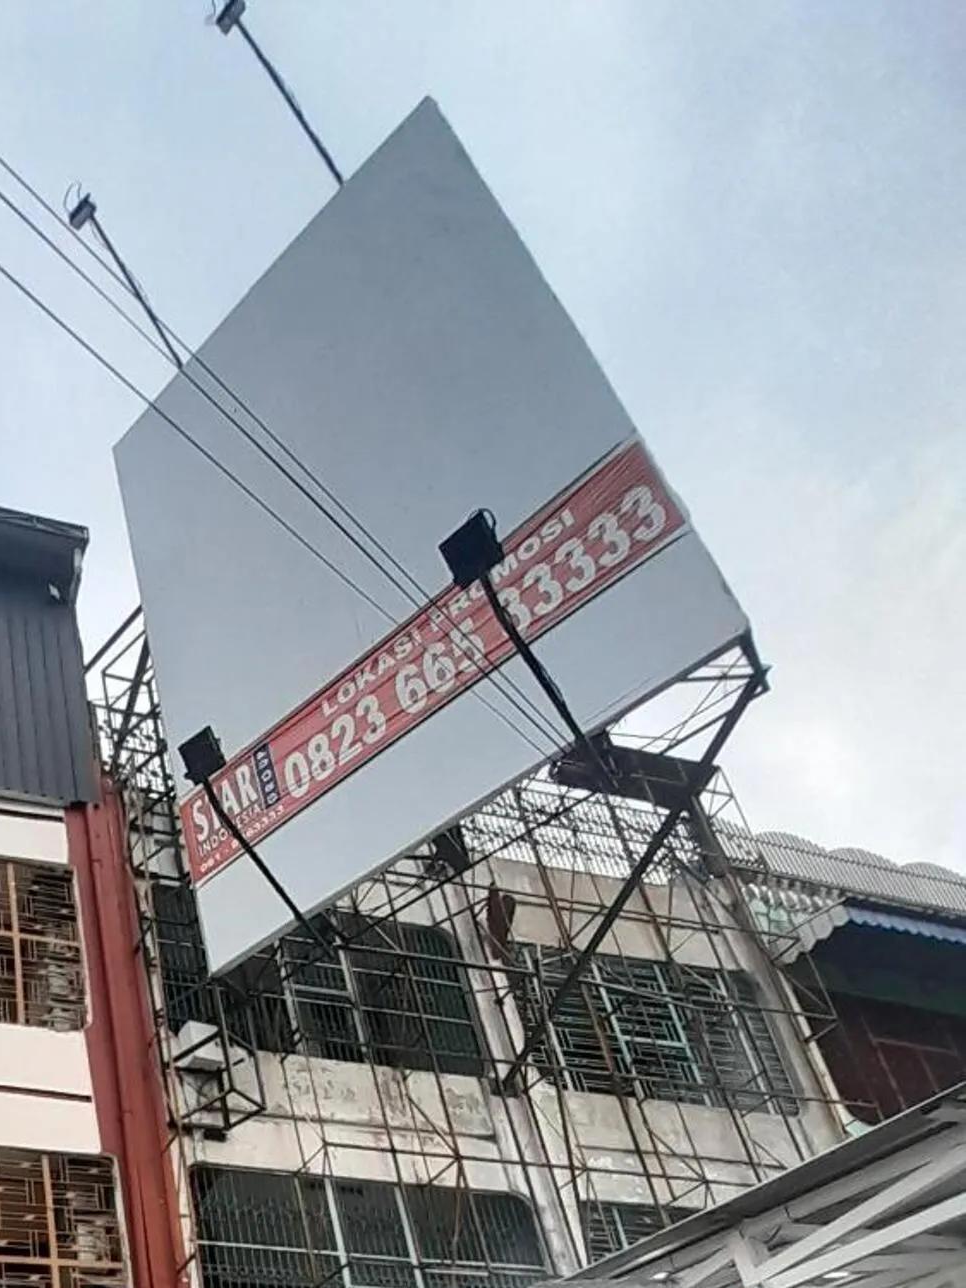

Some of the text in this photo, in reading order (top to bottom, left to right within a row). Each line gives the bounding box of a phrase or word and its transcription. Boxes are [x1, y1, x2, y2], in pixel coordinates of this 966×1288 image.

[284, 484, 667, 798] 0823 665 33333
[321, 630, 422, 718] LOKASI
[197, 802, 262, 858] INDOESIA
